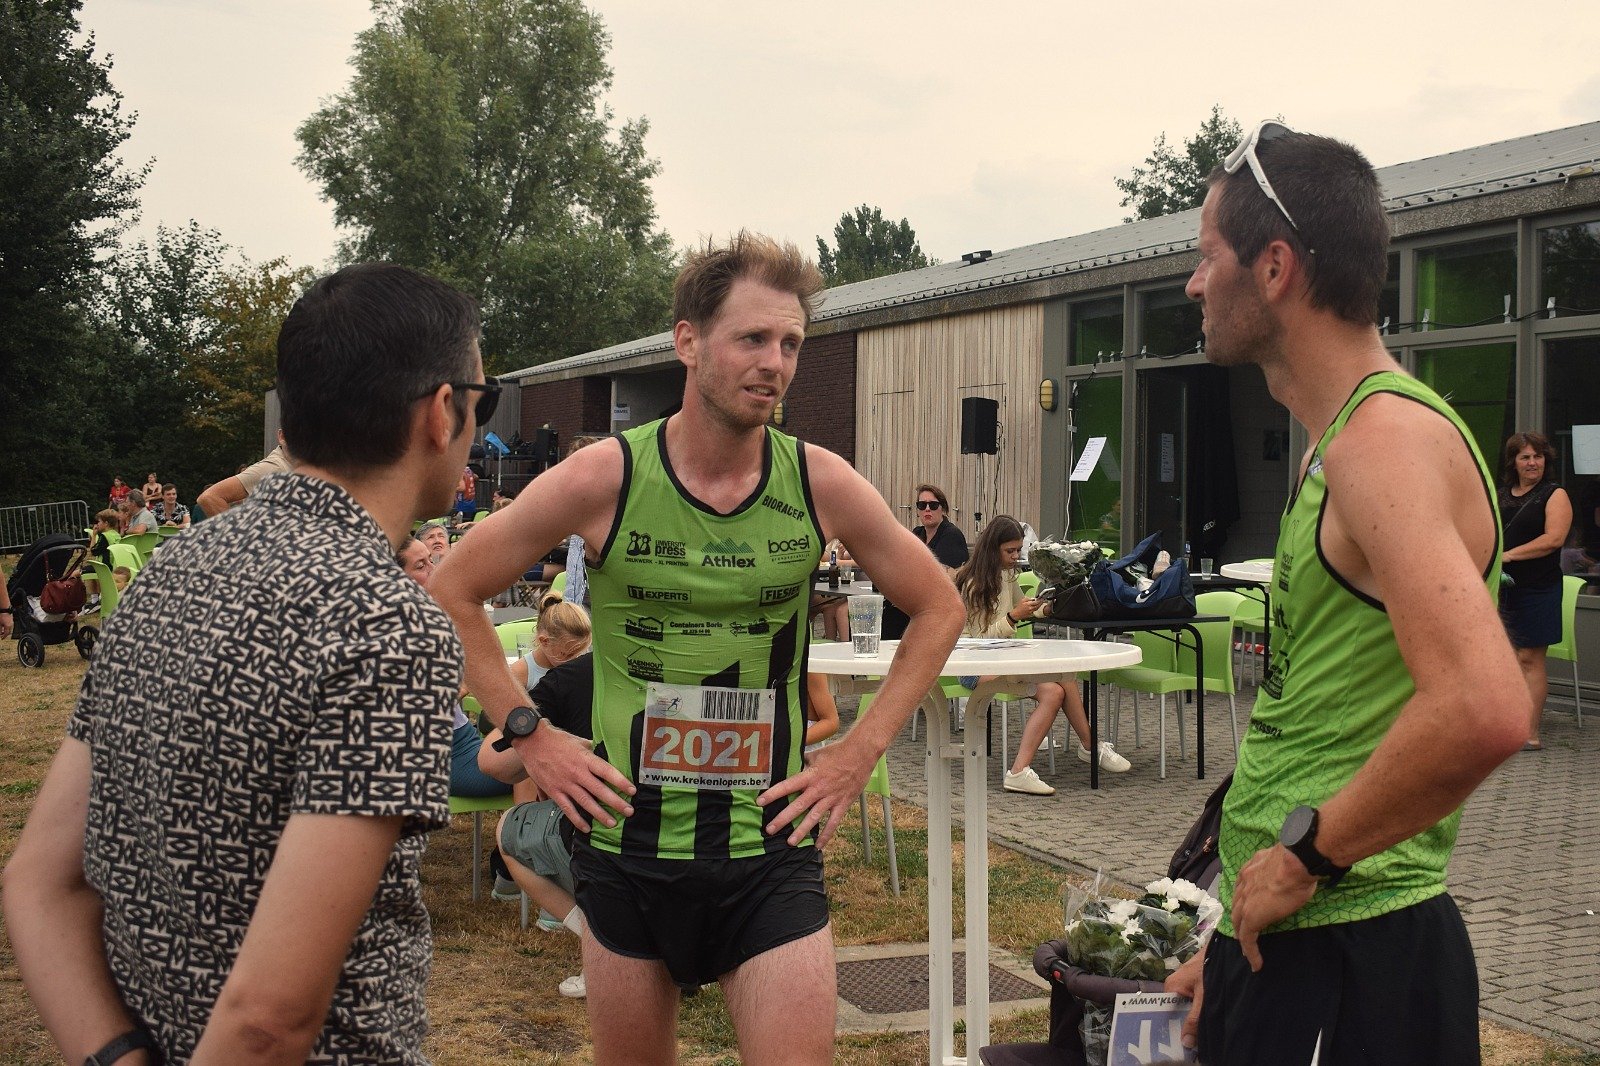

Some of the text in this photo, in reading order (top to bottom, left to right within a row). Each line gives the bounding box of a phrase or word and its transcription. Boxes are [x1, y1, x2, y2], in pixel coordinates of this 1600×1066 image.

[762, 495, 805, 522] BIORACER
[655, 545, 686, 557] press
[656, 540, 686, 548] UNIVERSITY
[701, 554, 756, 568] Athlex
[629, 586, 689, 601] IT EXPERTS
[650, 726, 761, 768] 2021
[651, 773, 762, 787] www.krekenlopers.be
